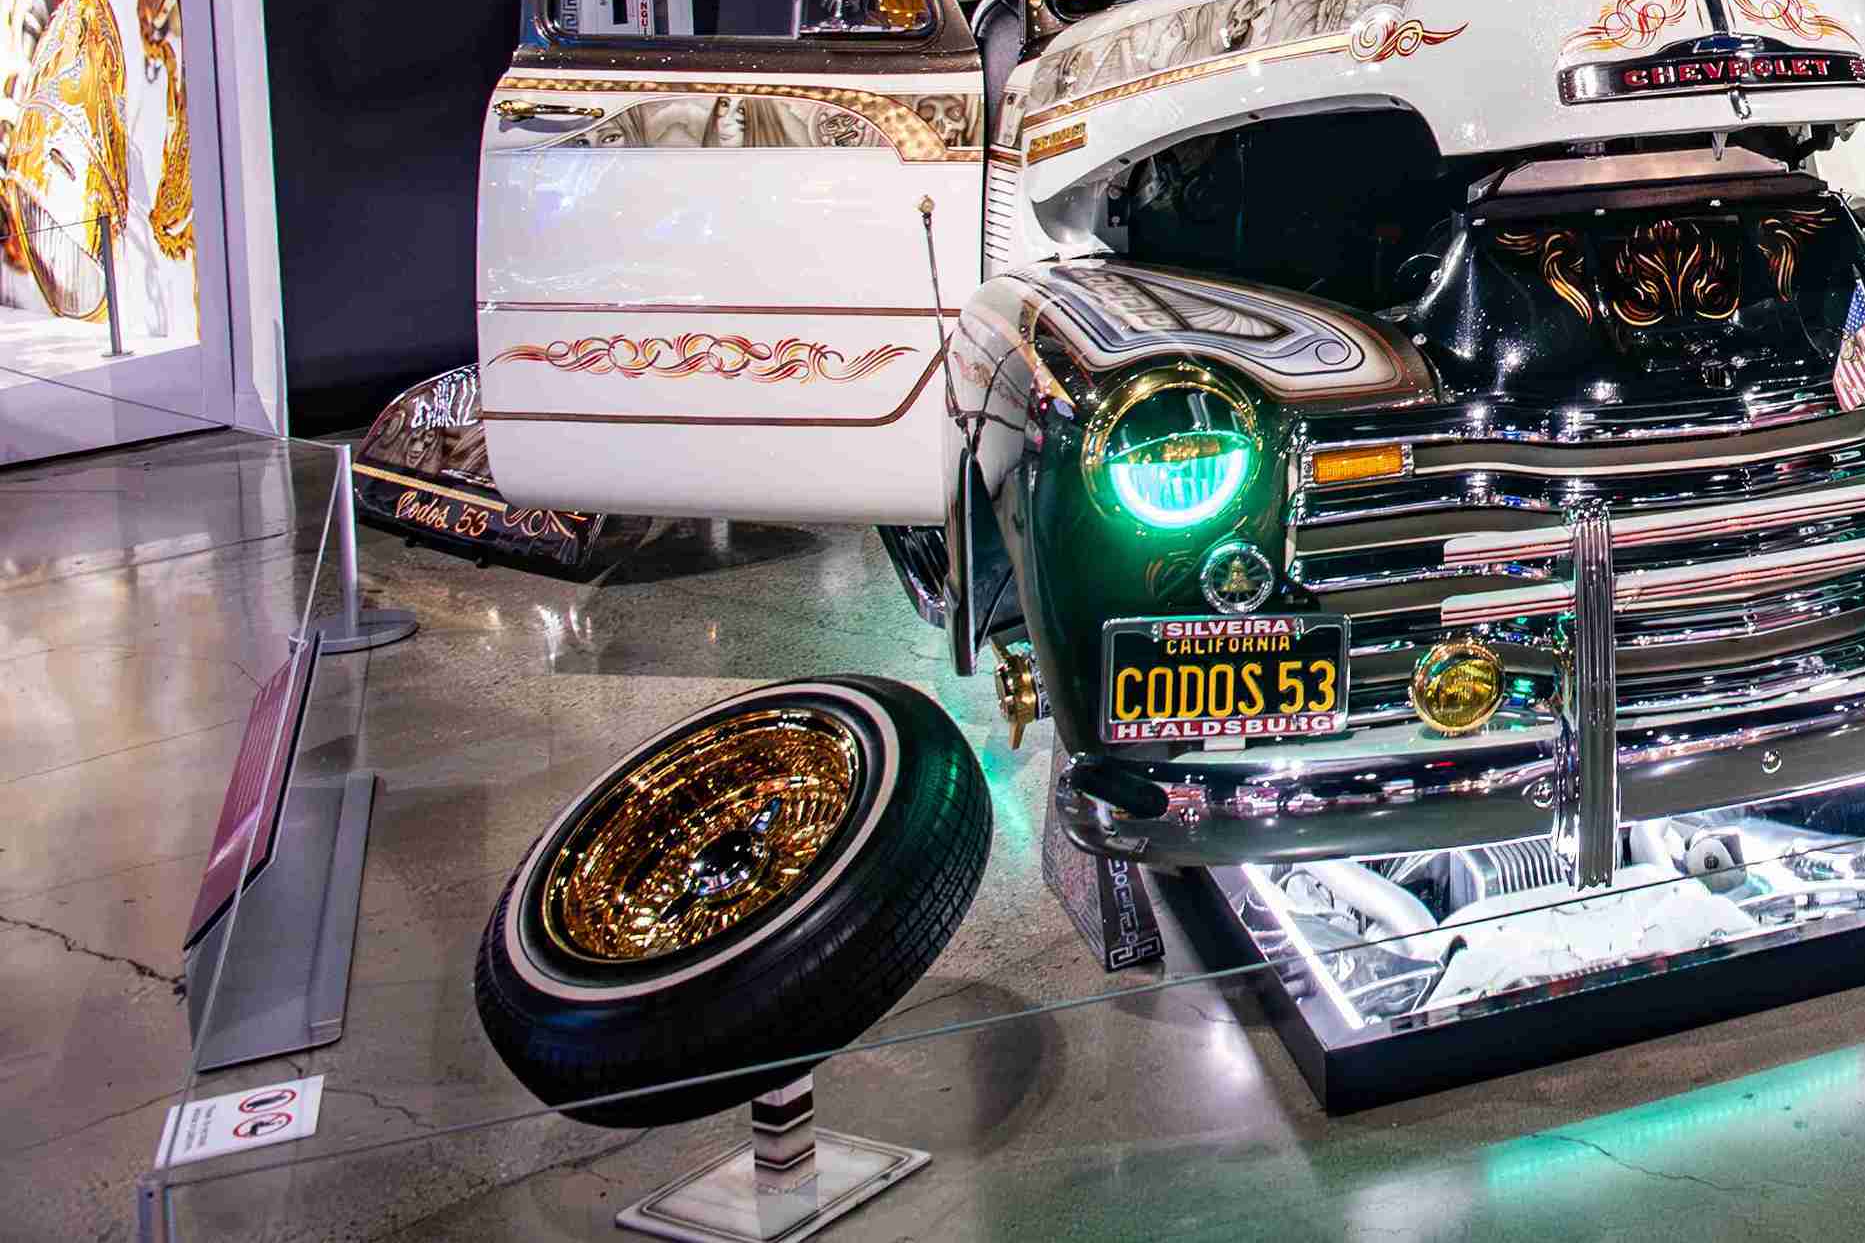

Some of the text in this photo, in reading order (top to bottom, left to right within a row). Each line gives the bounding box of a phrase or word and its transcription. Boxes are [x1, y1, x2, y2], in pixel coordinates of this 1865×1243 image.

[1624, 58, 1831, 87] CHEVROLET
[395, 491, 450, 529] Codos
[1166, 619, 1291, 636] SILVEIRA
[1167, 637, 1290, 655] CALIFORNIA
[1116, 659, 1337, 721] CODOS 53
[1117, 715, 1332, 739] HEALDSBURG
